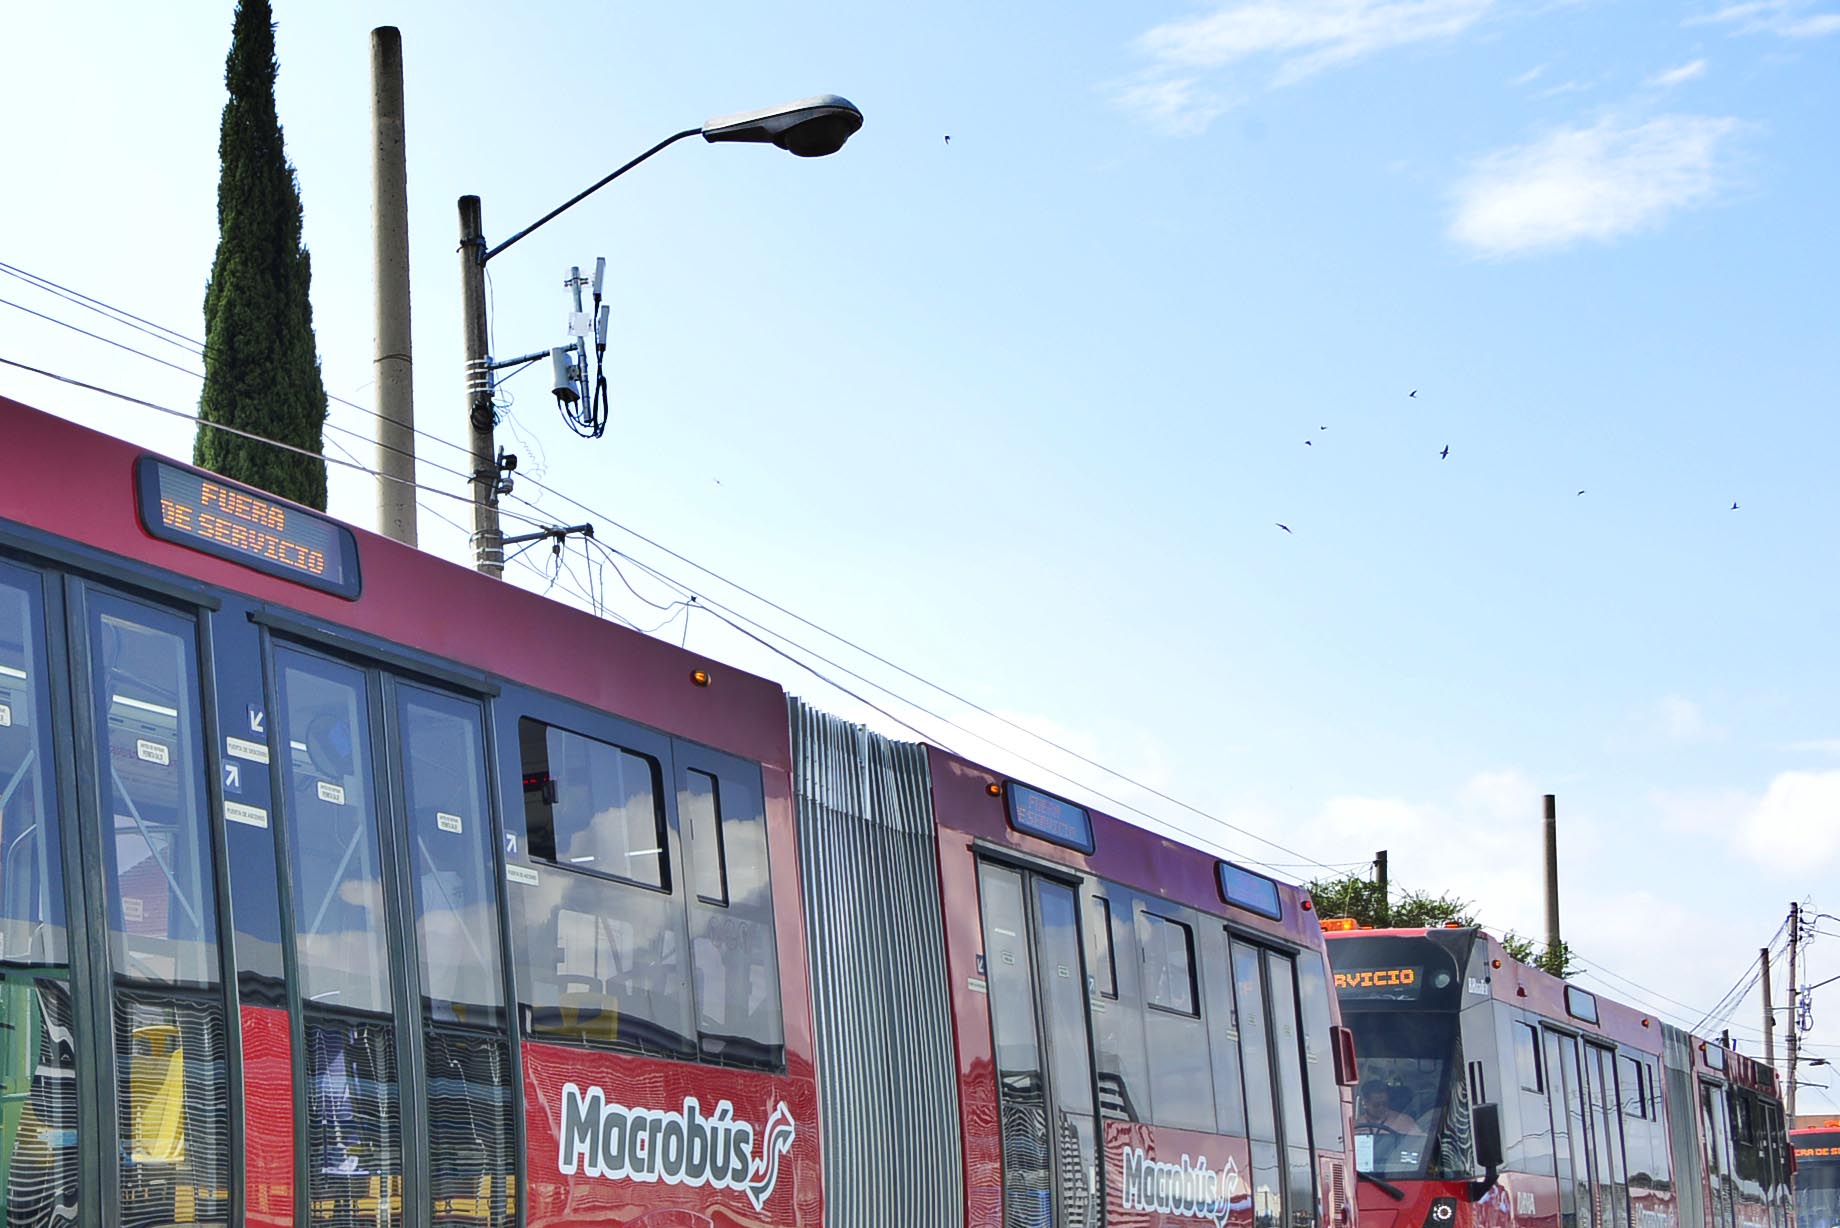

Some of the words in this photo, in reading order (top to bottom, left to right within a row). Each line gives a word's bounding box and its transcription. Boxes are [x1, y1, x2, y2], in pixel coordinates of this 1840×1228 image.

[160, 498, 193, 531] DE
[198, 512, 325, 574] SERVICIO
[201, 482, 286, 532] FUERA
[1334, 968, 1415, 988] RVICIO
[560, 1085, 752, 1188] Macrobús
[1123, 1148, 1217, 1217] Macrobús
